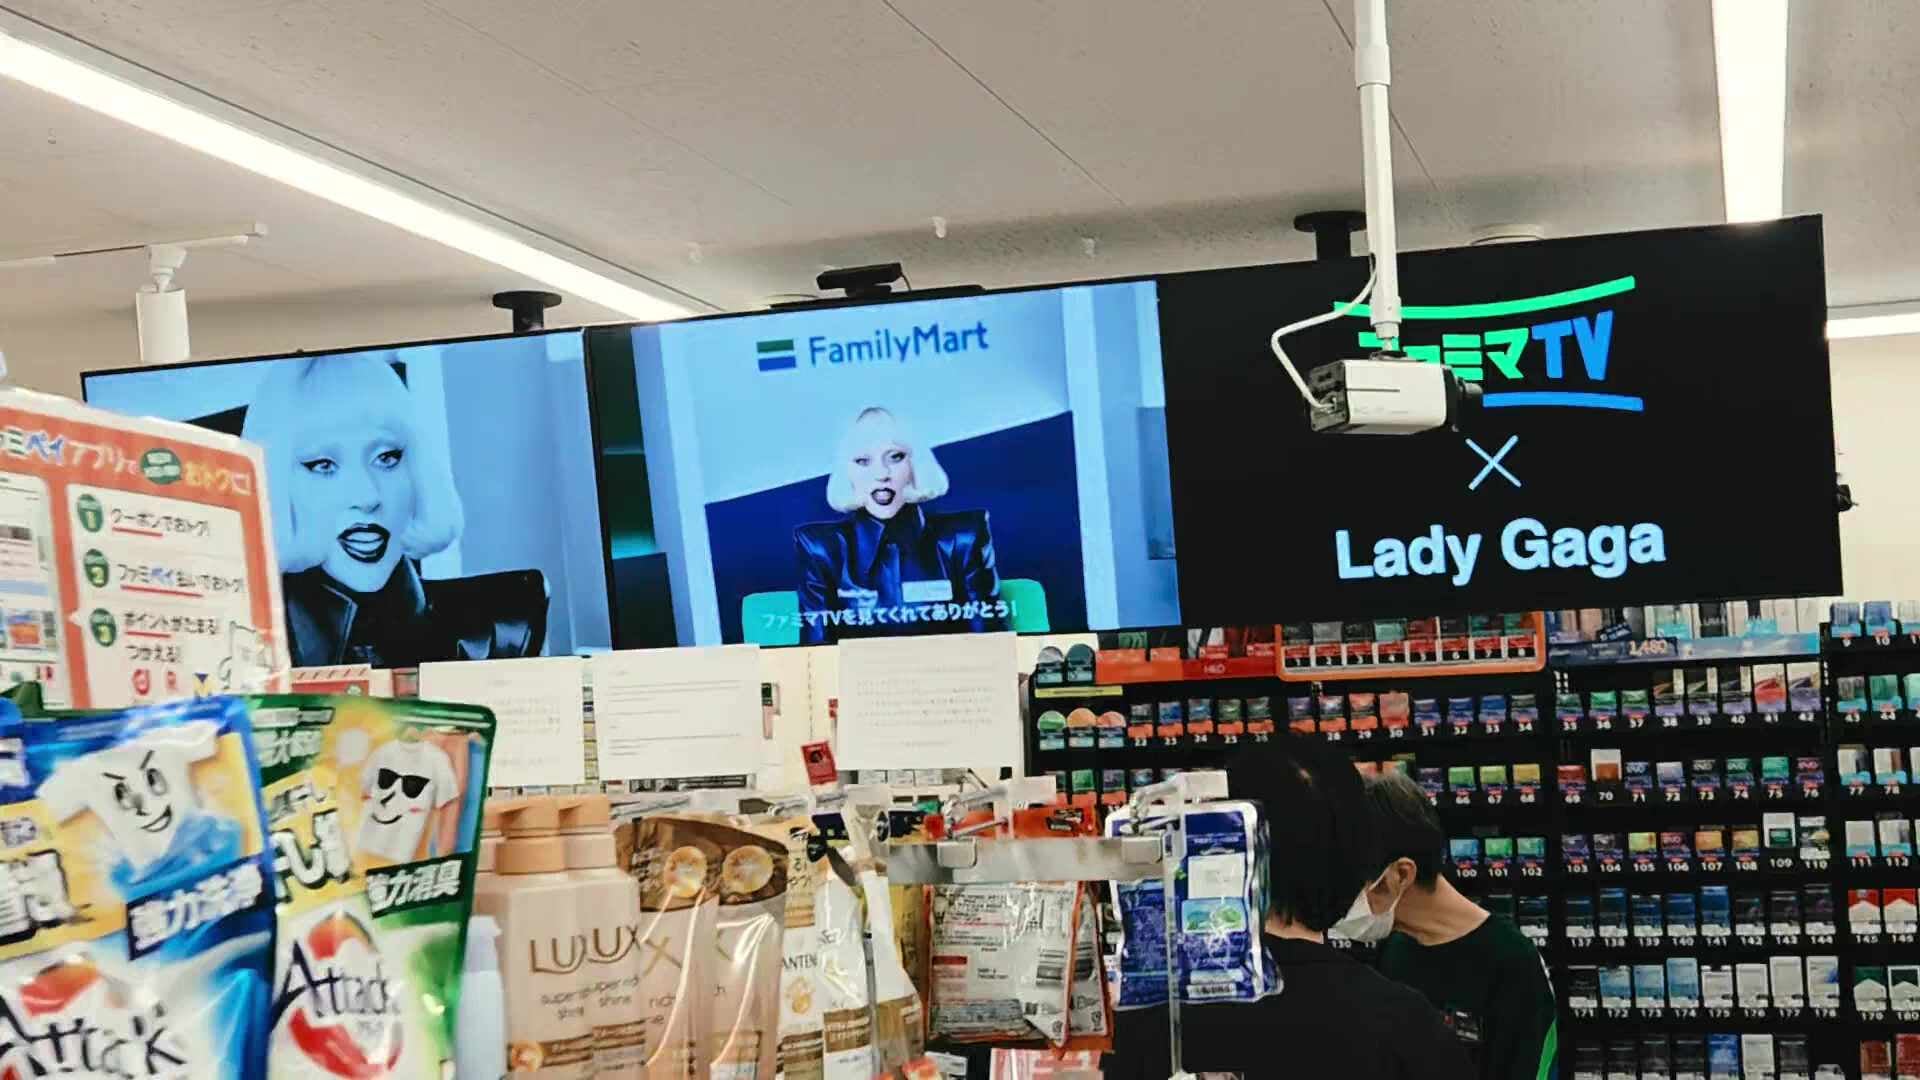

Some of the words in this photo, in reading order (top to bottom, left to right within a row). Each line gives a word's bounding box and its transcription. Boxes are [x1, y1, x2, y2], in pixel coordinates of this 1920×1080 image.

[809, 321, 988, 367] FamilyMart
[1335, 524, 1482, 587] Lady
[1500, 517, 1666, 579] Gaga
[1875, 634, 1891, 646] 10
[1911, 634, 1920, 646] 1
[1731, 715, 1746, 724] 40
[1764, 713, 1779, 722] 41
[1798, 712, 1814, 721] 42
[1880, 710, 1897, 720] 44
[1596, 719, 1612, 729] 36
[1629, 719, 1644, 728] 37
[1662, 717, 1678, 727] 38
[1697, 715, 1712, 725] 39
[1358, 731, 1372, 739] 29
[1389, 729, 1404, 738] 30
[1700, 790, 1714, 799] 73
[1734, 789, 1749, 798] 74
[1768, 787, 1783, 797] 75
[1803, 786, 1819, 797] 76
[1849, 787, 1864, 795] 77
[1884, 786, 1900, 795] 78
[1487, 795, 1502, 804] 67
[1599, 792, 1614, 801] 70
[1633, 792, 1646, 801] 71
[1665, 791, 1681, 801] 72
[1770, 858, 1793, 867] 109
[1805, 859, 1828, 868] 110
[1851, 857, 1872, 866] 111
[1886, 857, 1909, 866] 112
[1521, 866, 1543, 876] 102
[1567, 865, 1588, 873] 103
[1600, 864, 1621, 873] 104
[1633, 862, 1656, 871] 105
[1667, 863, 1690, 872] 106
[1701, 862, 1723, 871] 107
[1735, 862, 1758, 871] 108
[1456, 869, 1478, 878] 100
[1489, 869, 1508, 877] 101
[1571, 938, 1592, 947] 137
[1604, 938, 1625, 947] 138
[1639, 938, 1660, 947] 139
[1672, 937, 1695, 946] 140
[1706, 937, 1727, 945] 141
[1740, 935, 1763, 945] 142
[1775, 935, 1798, 944] 143
[1811, 936, 1833, 944] 144
[1856, 935, 1878, 944] 145
[1574, 1008, 1594, 1017] 171
[1607, 1008, 1628, 1017] 172
[1641, 1007, 1662, 1017] 173
[1674, 1007, 1696, 1017] 174
[1709, 1007, 1730, 1017] 175
[1744, 1007, 1766, 1016] 176
[1779, 1007, 1801, 1016] 177
[1815, 1007, 1837, 1016] 178
[1897, 1010, 1920, 1020] 180
